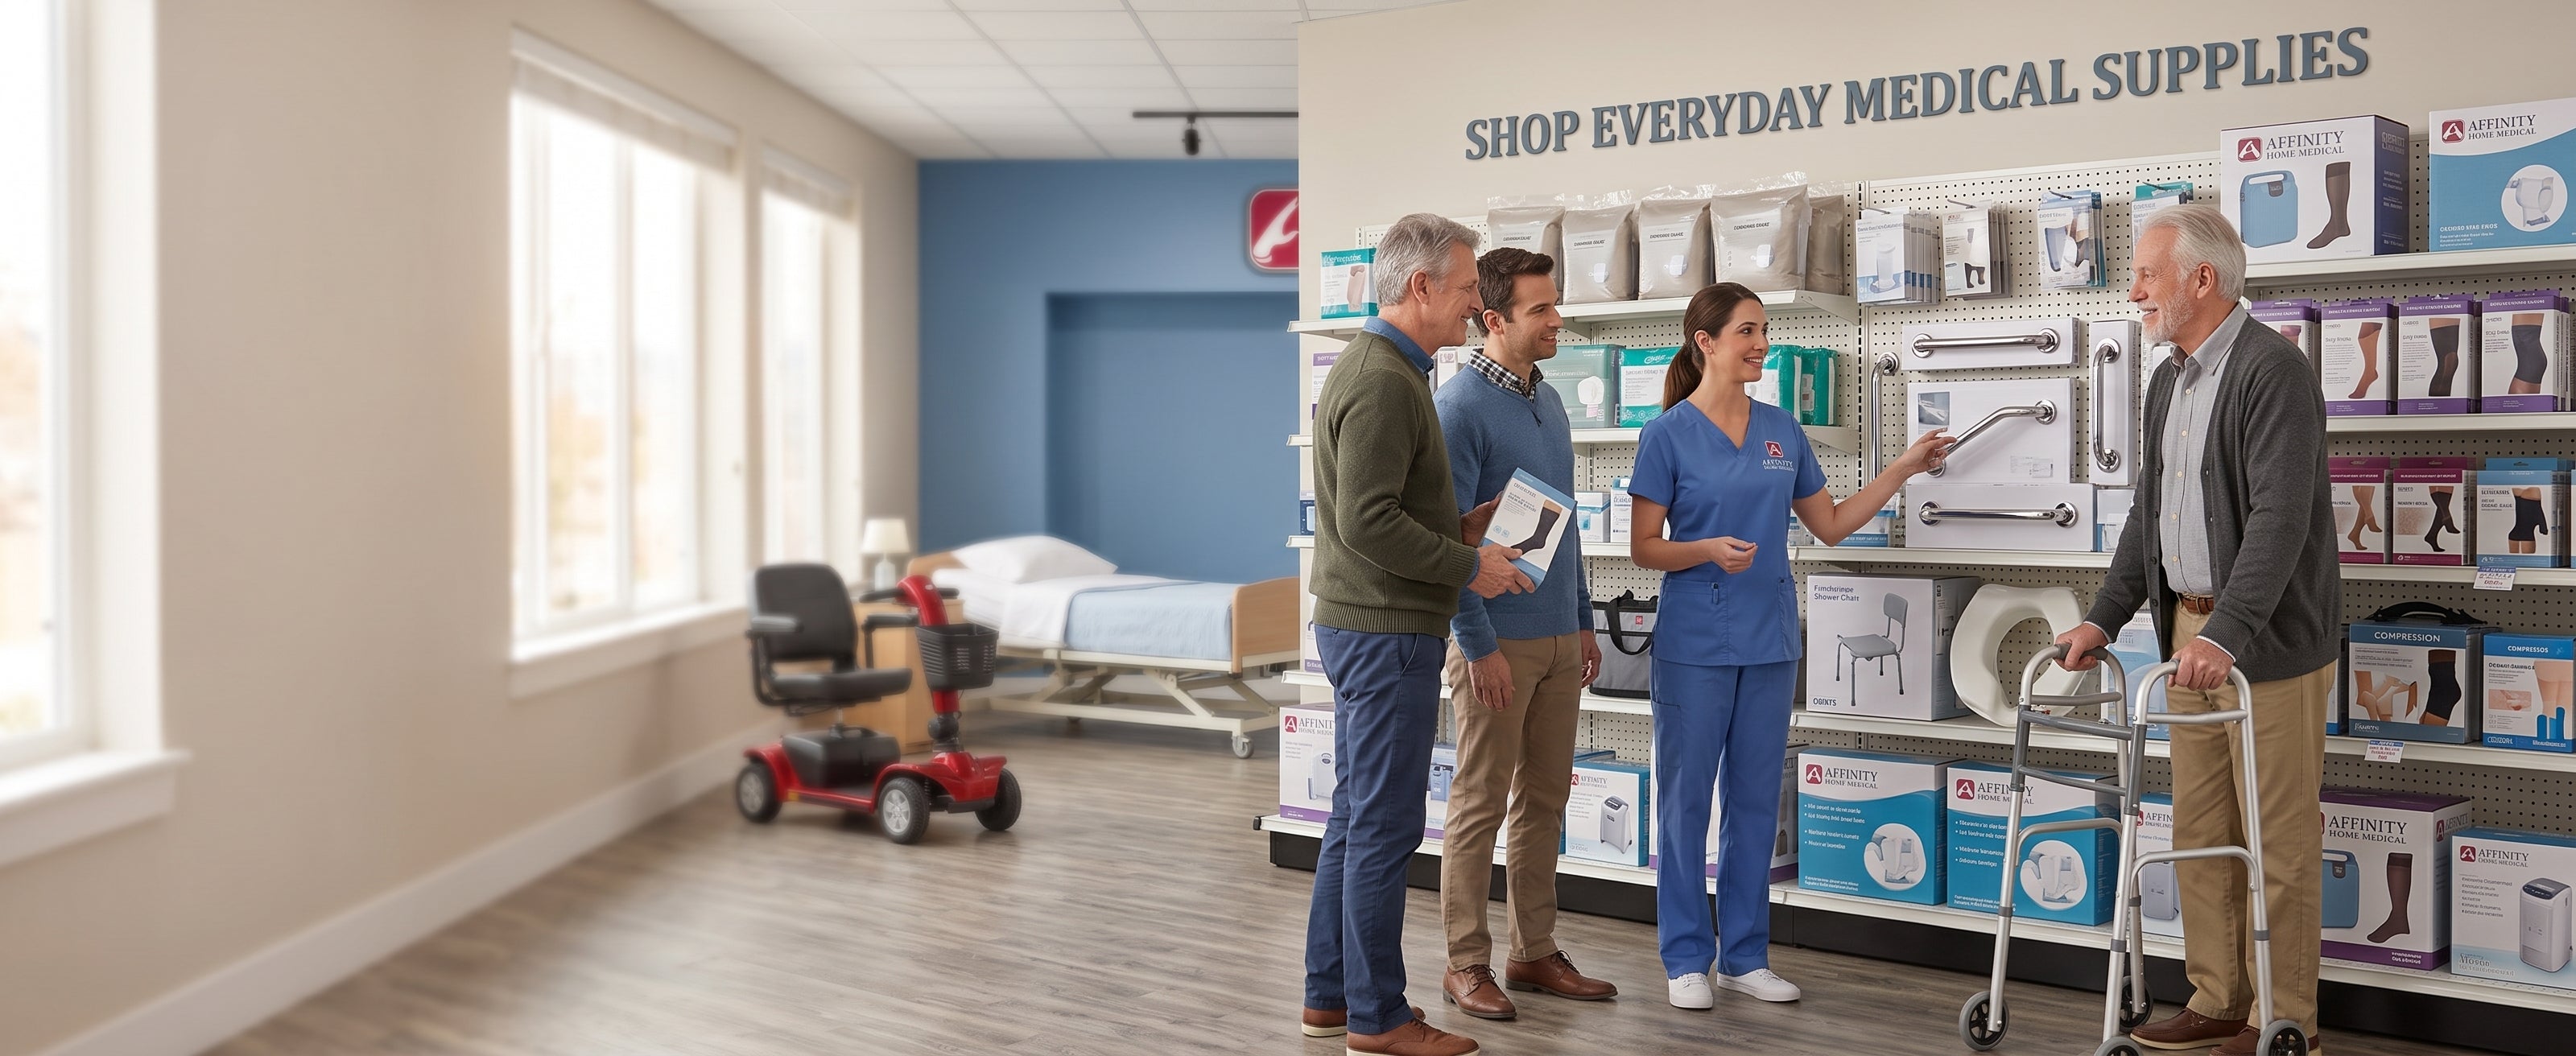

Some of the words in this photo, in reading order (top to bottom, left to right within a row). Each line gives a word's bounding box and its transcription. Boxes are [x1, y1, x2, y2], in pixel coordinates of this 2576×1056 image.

[1465, 110, 1579, 160] SHOP
[1591, 83, 1831, 148] EVERYDAY
[1843, 59, 2078, 125] MEDICAL
[2092, 27, 2368, 101] SUPPLIES
[2468, 115, 2537, 131] AFFINITY
[2266, 131, 2344, 150] AFFINITY
[2469, 132, 2494, 140] HOME
[2496, 128, 2537, 138] MEDICAL
[2267, 150, 2296, 160] HOME
[2298, 146, 2345, 157] MEDICAL
[1814, 593, 1839, 601] Shower
[2374, 632, 2440, 642] COMPRESSION
[1298, 718, 1334, 729] AFFINIT
[1825, 768, 1878, 782] AFFINITY
[1977, 782, 2034, 797] AFFINY
[2329, 815, 2407, 835] AFFINITY
[2329, 830, 2359, 839] HOME
[2362, 834, 2407, 844] MEDICAL
[2479, 848, 2529, 862] AFFINITY
